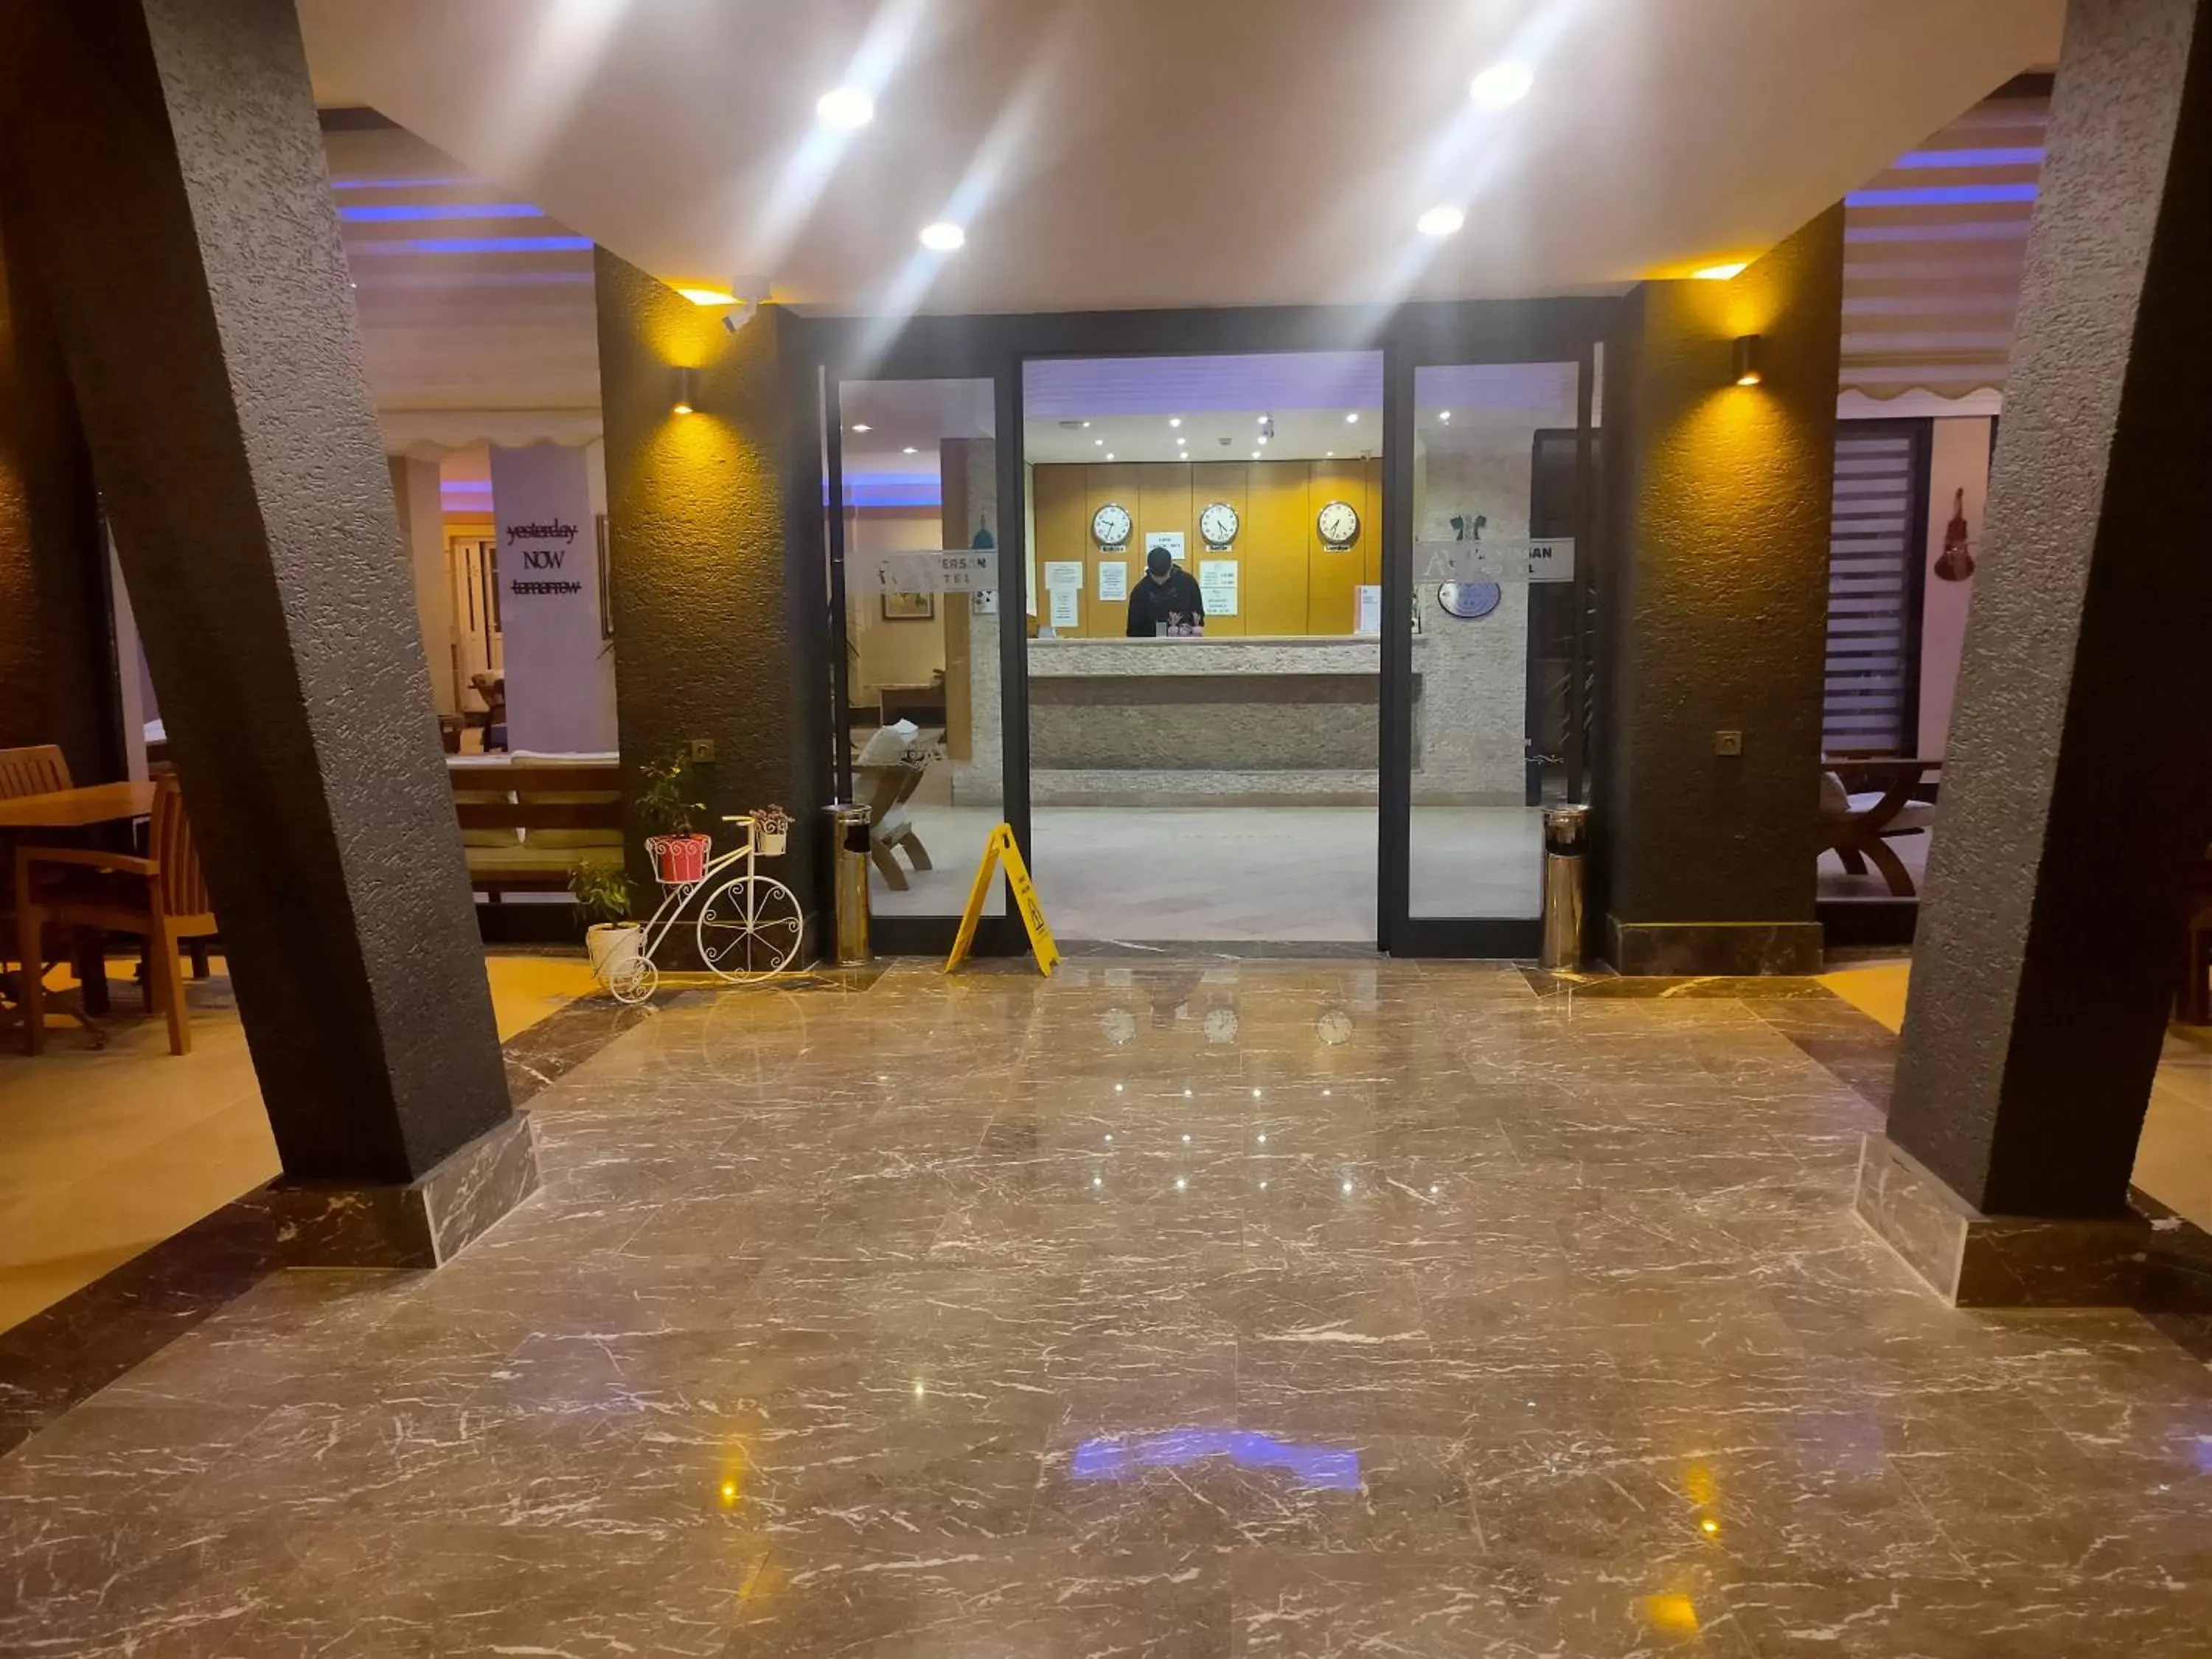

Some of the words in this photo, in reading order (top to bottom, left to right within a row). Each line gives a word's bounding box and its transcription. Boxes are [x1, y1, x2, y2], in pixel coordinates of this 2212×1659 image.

[507, 518, 579, 546] yesterday
[523, 551, 565, 569] NOW
[510, 579, 582, 595] tomorrow
